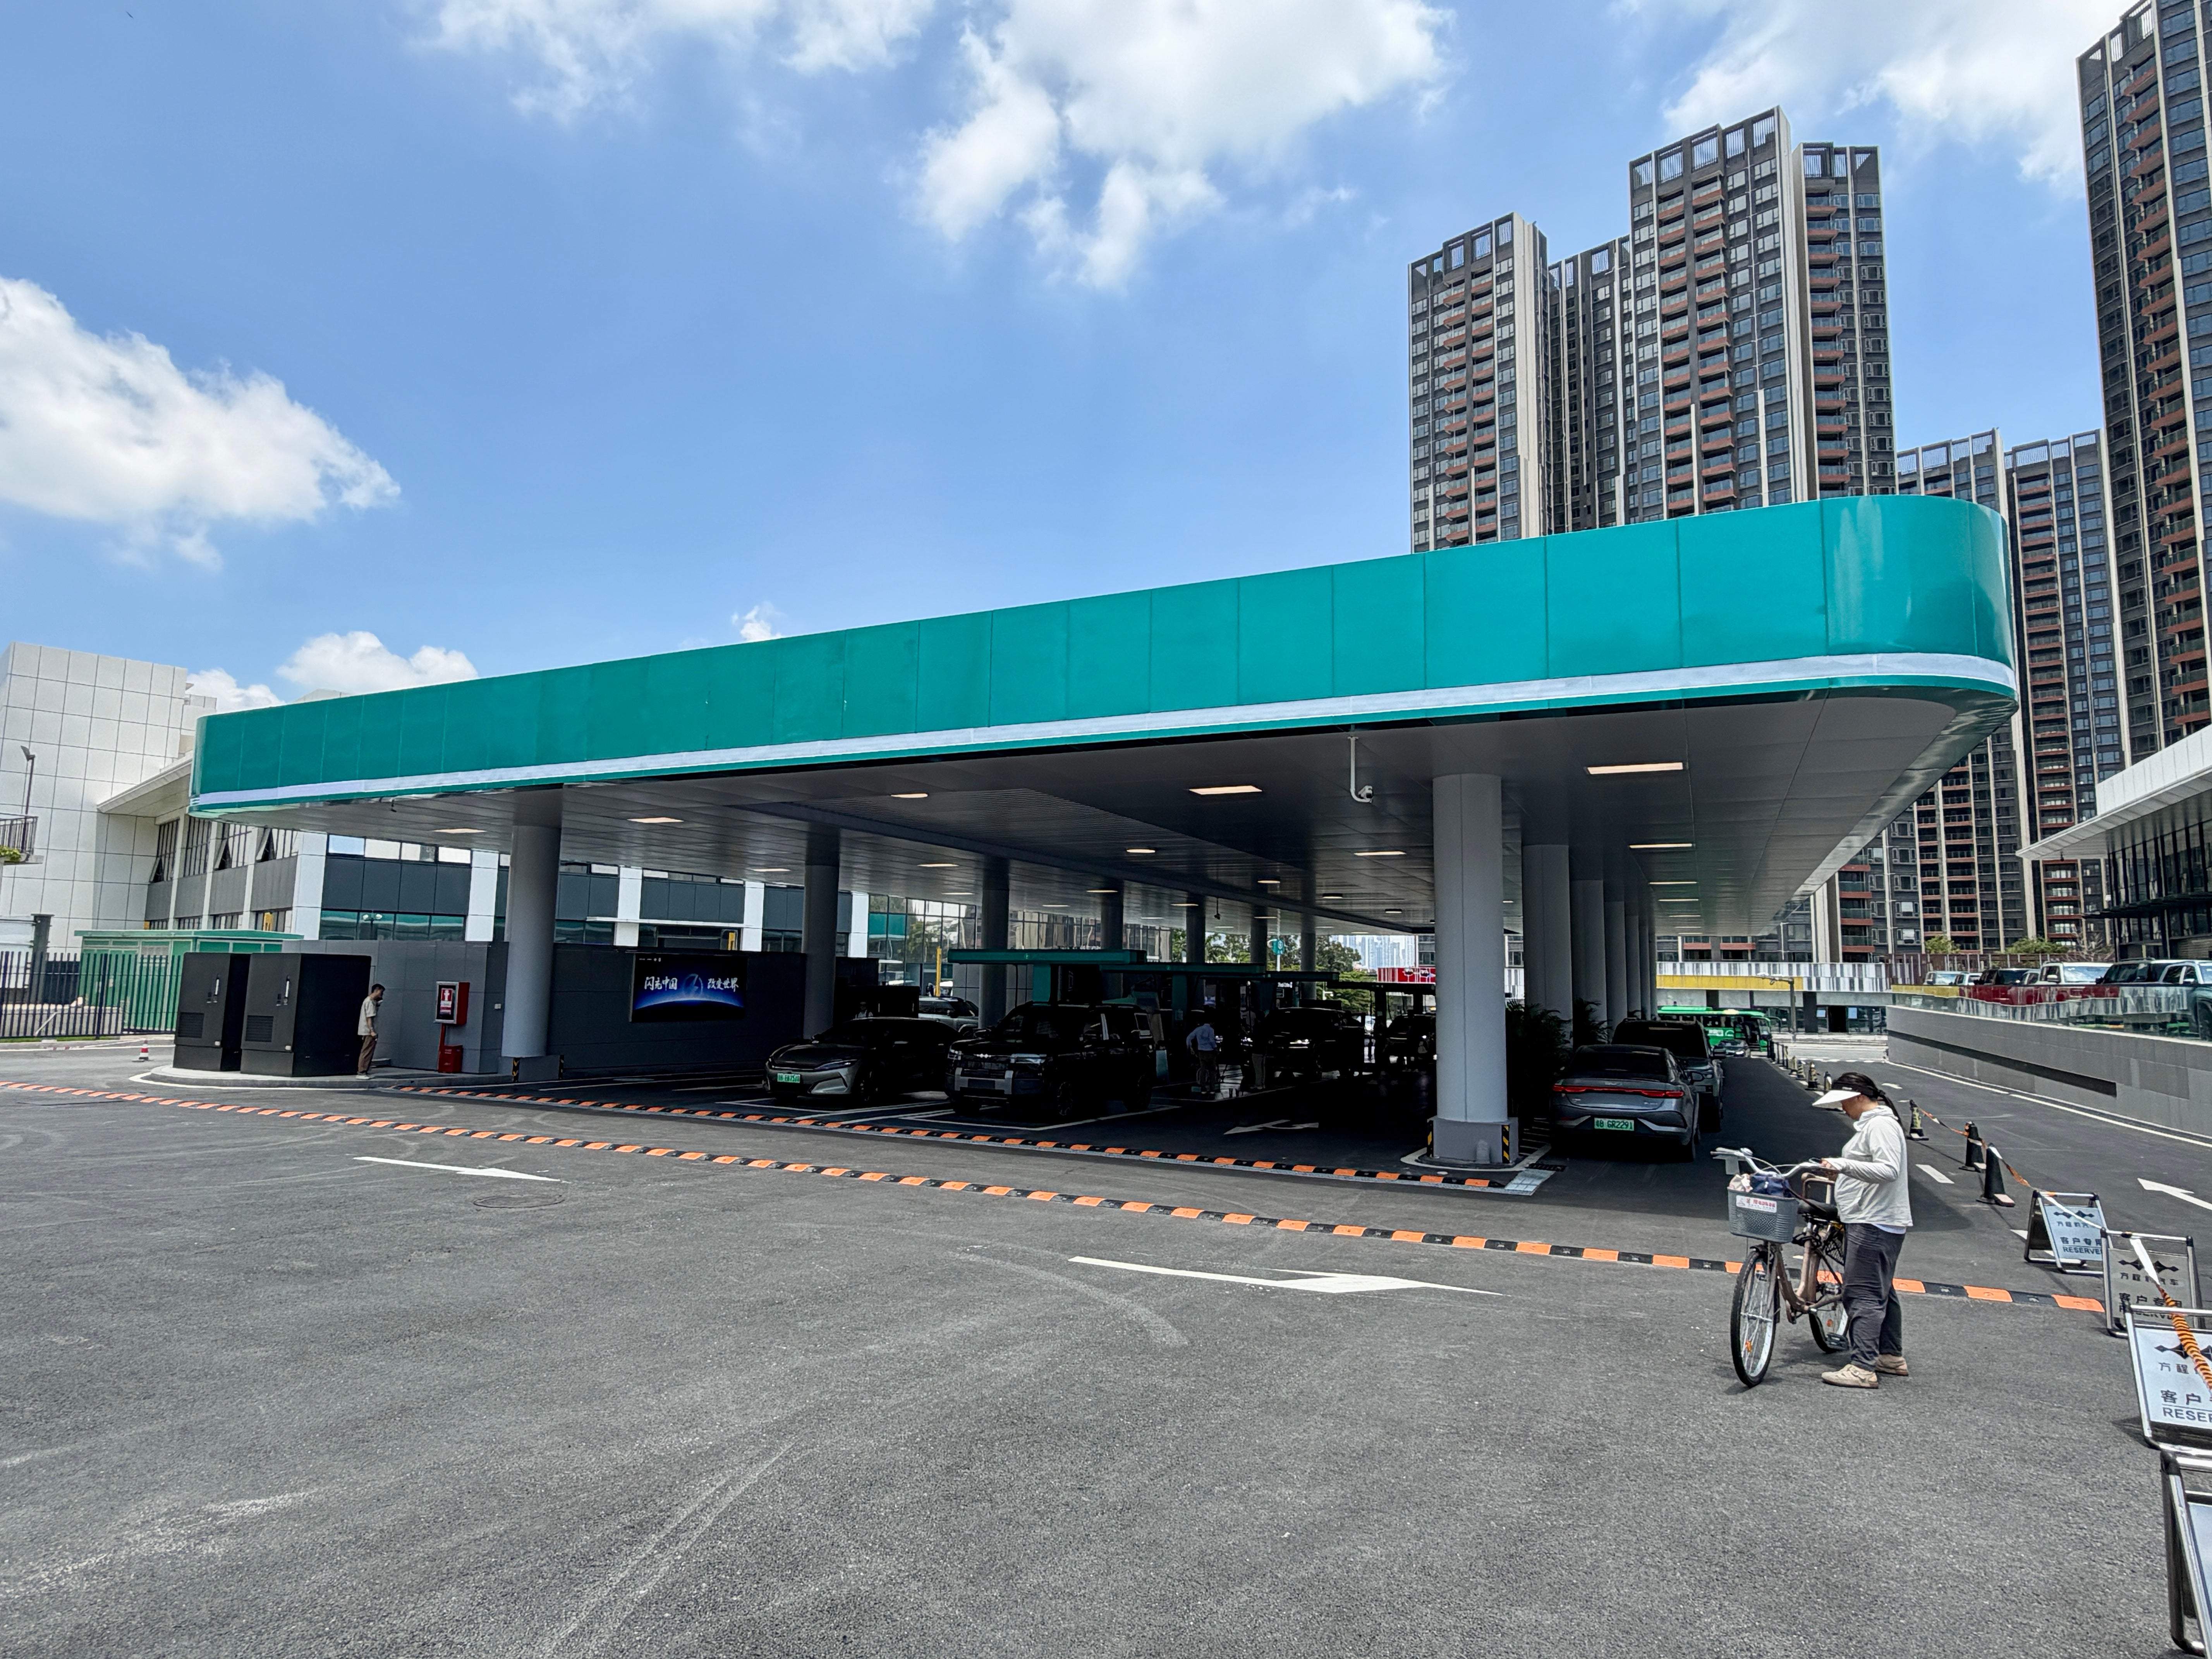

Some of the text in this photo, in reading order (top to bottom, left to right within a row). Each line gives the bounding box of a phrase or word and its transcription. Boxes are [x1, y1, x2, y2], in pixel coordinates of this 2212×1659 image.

[707, 977, 739, 992] 改变世界
[2158, 1362, 2198, 1374] 方程
[2160, 1389, 2212, 1405] 客户
